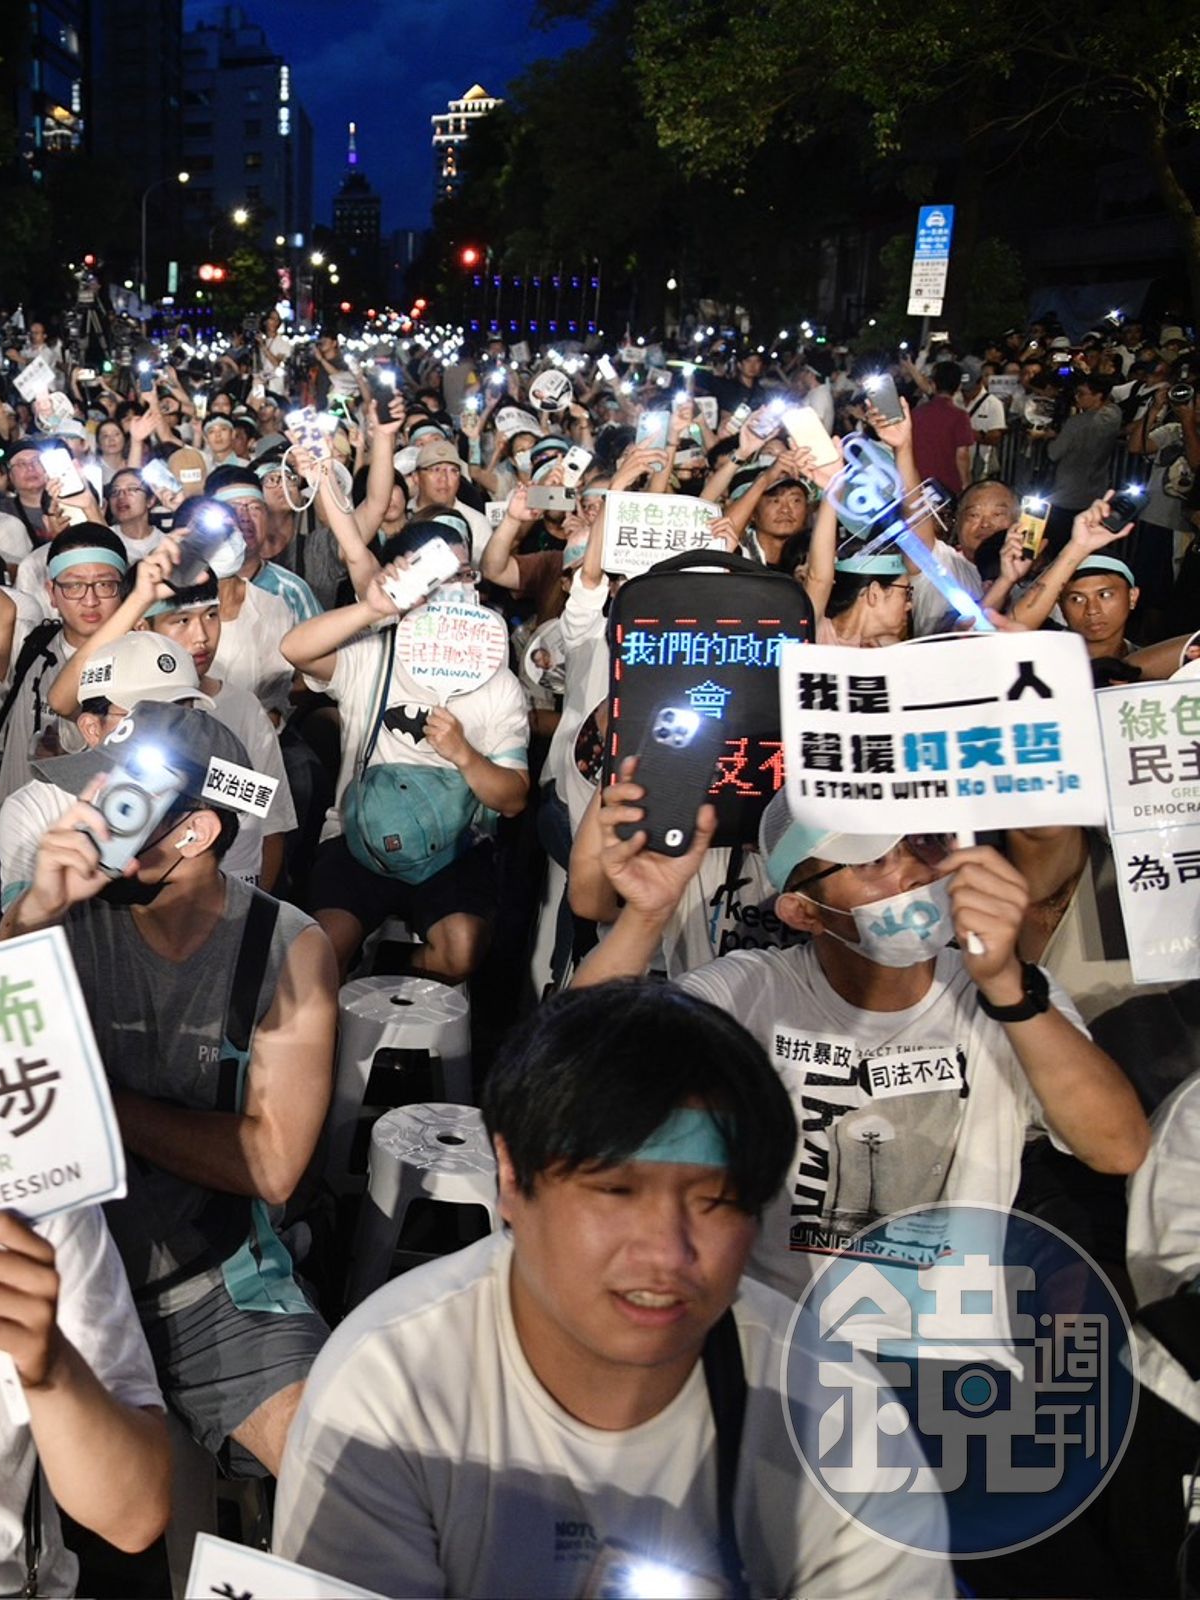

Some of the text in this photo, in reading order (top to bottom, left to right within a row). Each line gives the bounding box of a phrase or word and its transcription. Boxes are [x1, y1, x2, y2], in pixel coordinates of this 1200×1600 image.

[615, 502, 713, 527] 綠色恐怖
[616, 526, 712, 551] 民主退步
[447, 606, 490, 620] TAIWAN
[412, 667, 482, 679] IN TAIWAN
[801, 722, 1063, 773] 聲援柯文哲
[207, 768, 273, 808] 政治迫害
[892, 780, 948, 800] WITH
[957, 778, 985, 796] Ko
[993, 770, 1081, 796] Wen-je
[775, 1034, 851, 1069] 對抗暴政
[870, 1057, 956, 1089] 司法不公
